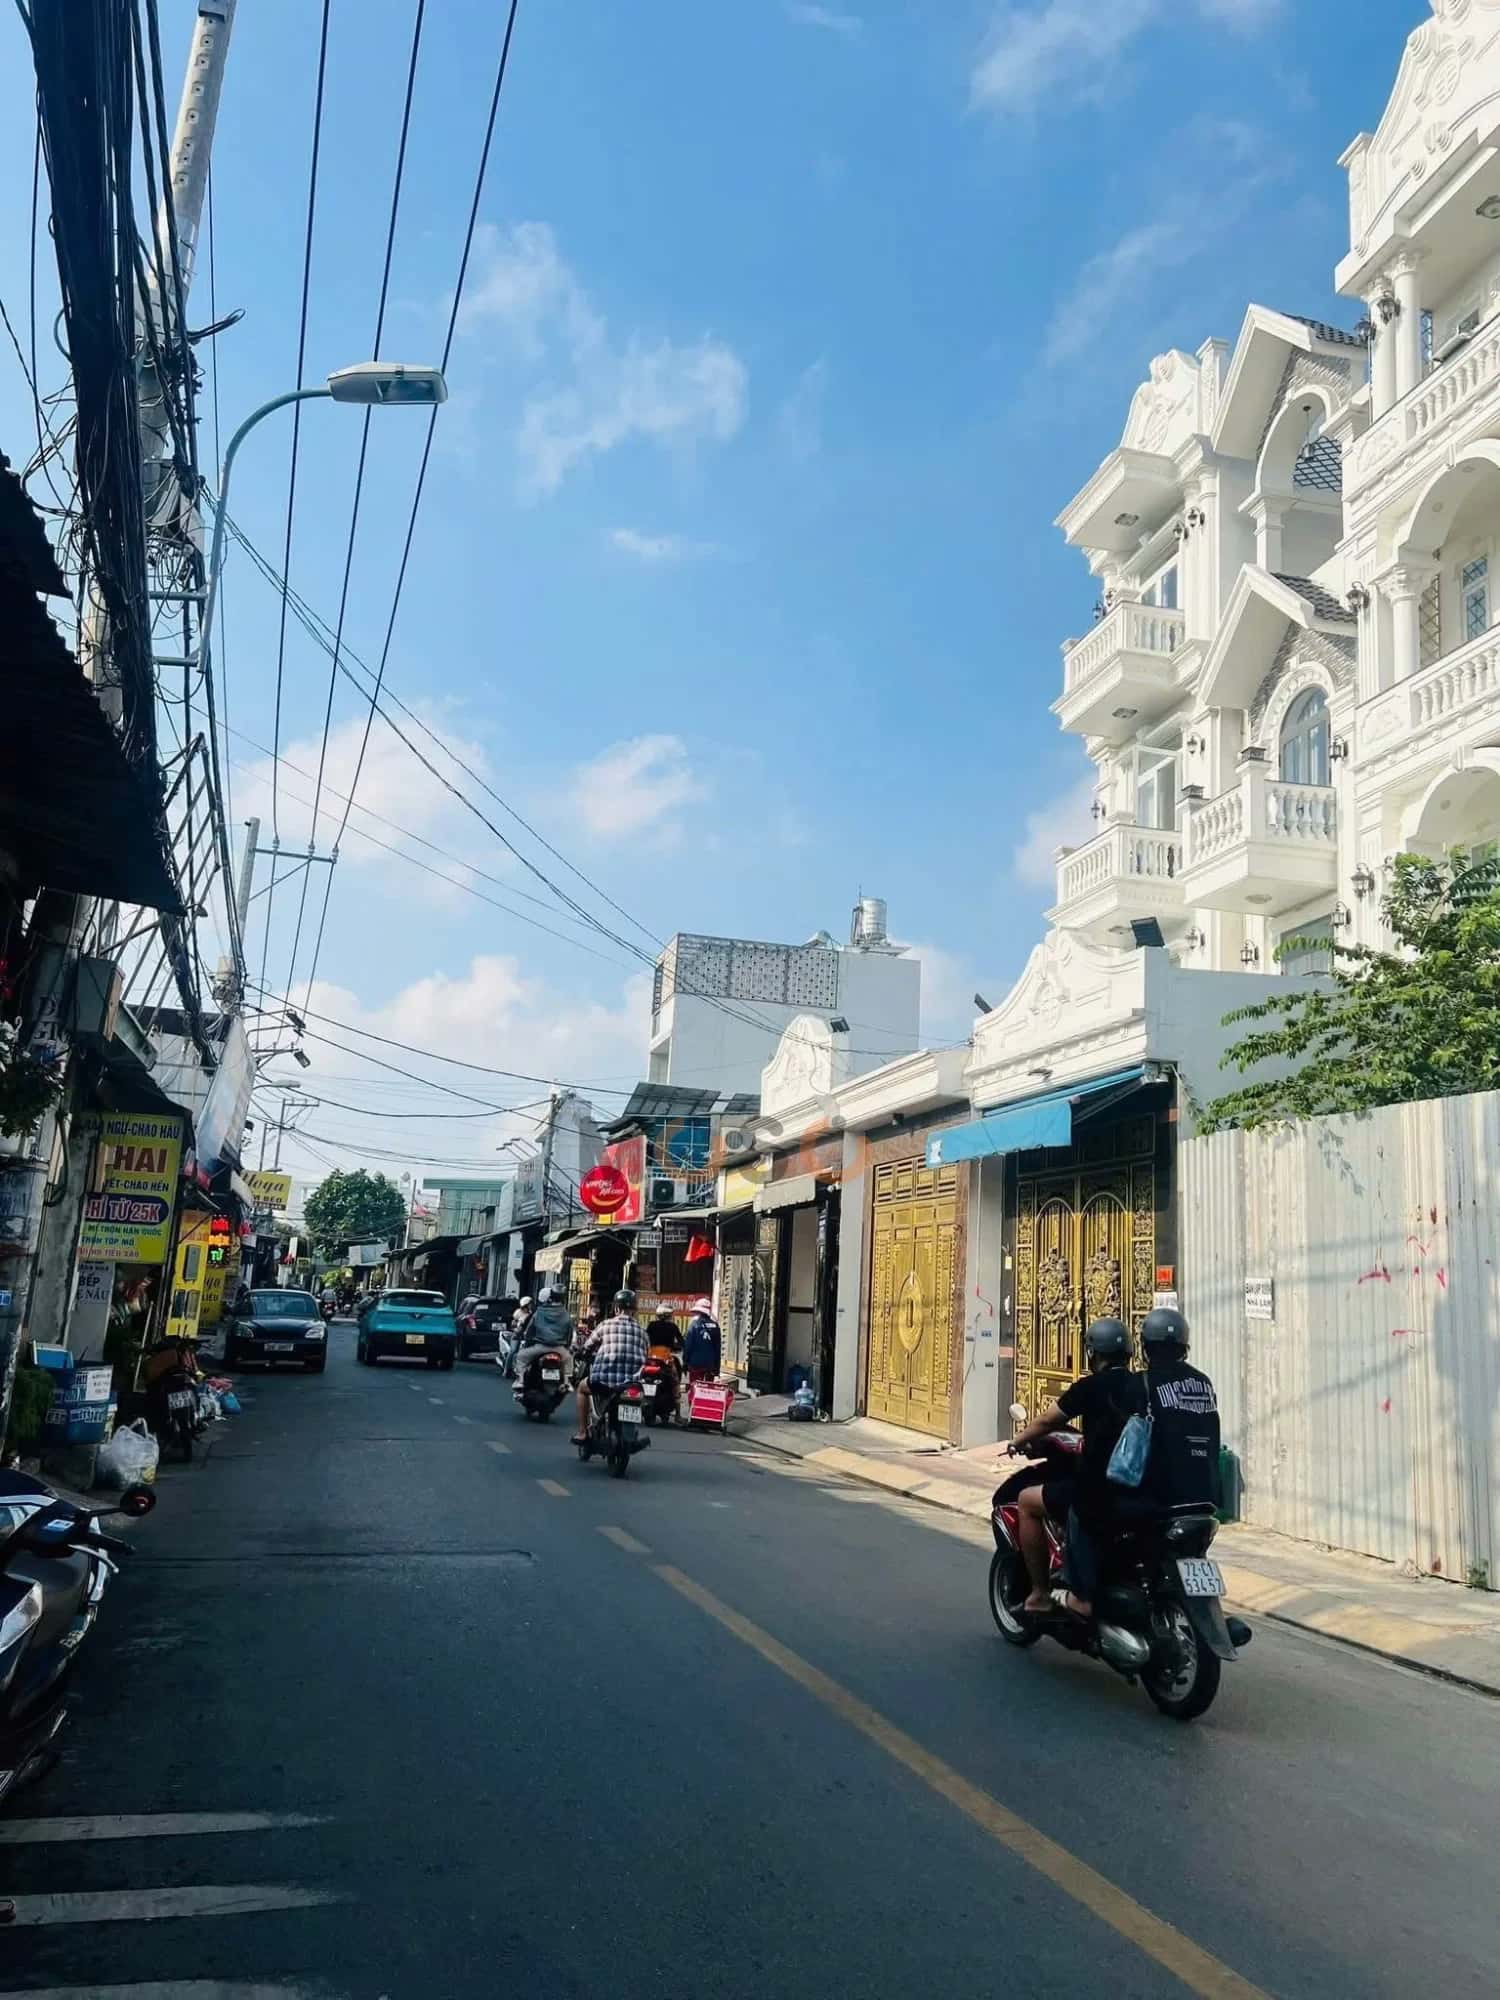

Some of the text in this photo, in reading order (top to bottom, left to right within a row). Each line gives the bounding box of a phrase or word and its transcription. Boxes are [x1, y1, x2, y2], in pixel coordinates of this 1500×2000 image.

[114, 1145, 167, 1173] HAI
[130, 1202, 162, 1222] 25K
[1184, 1561, 1215, 1577] 72-C1
